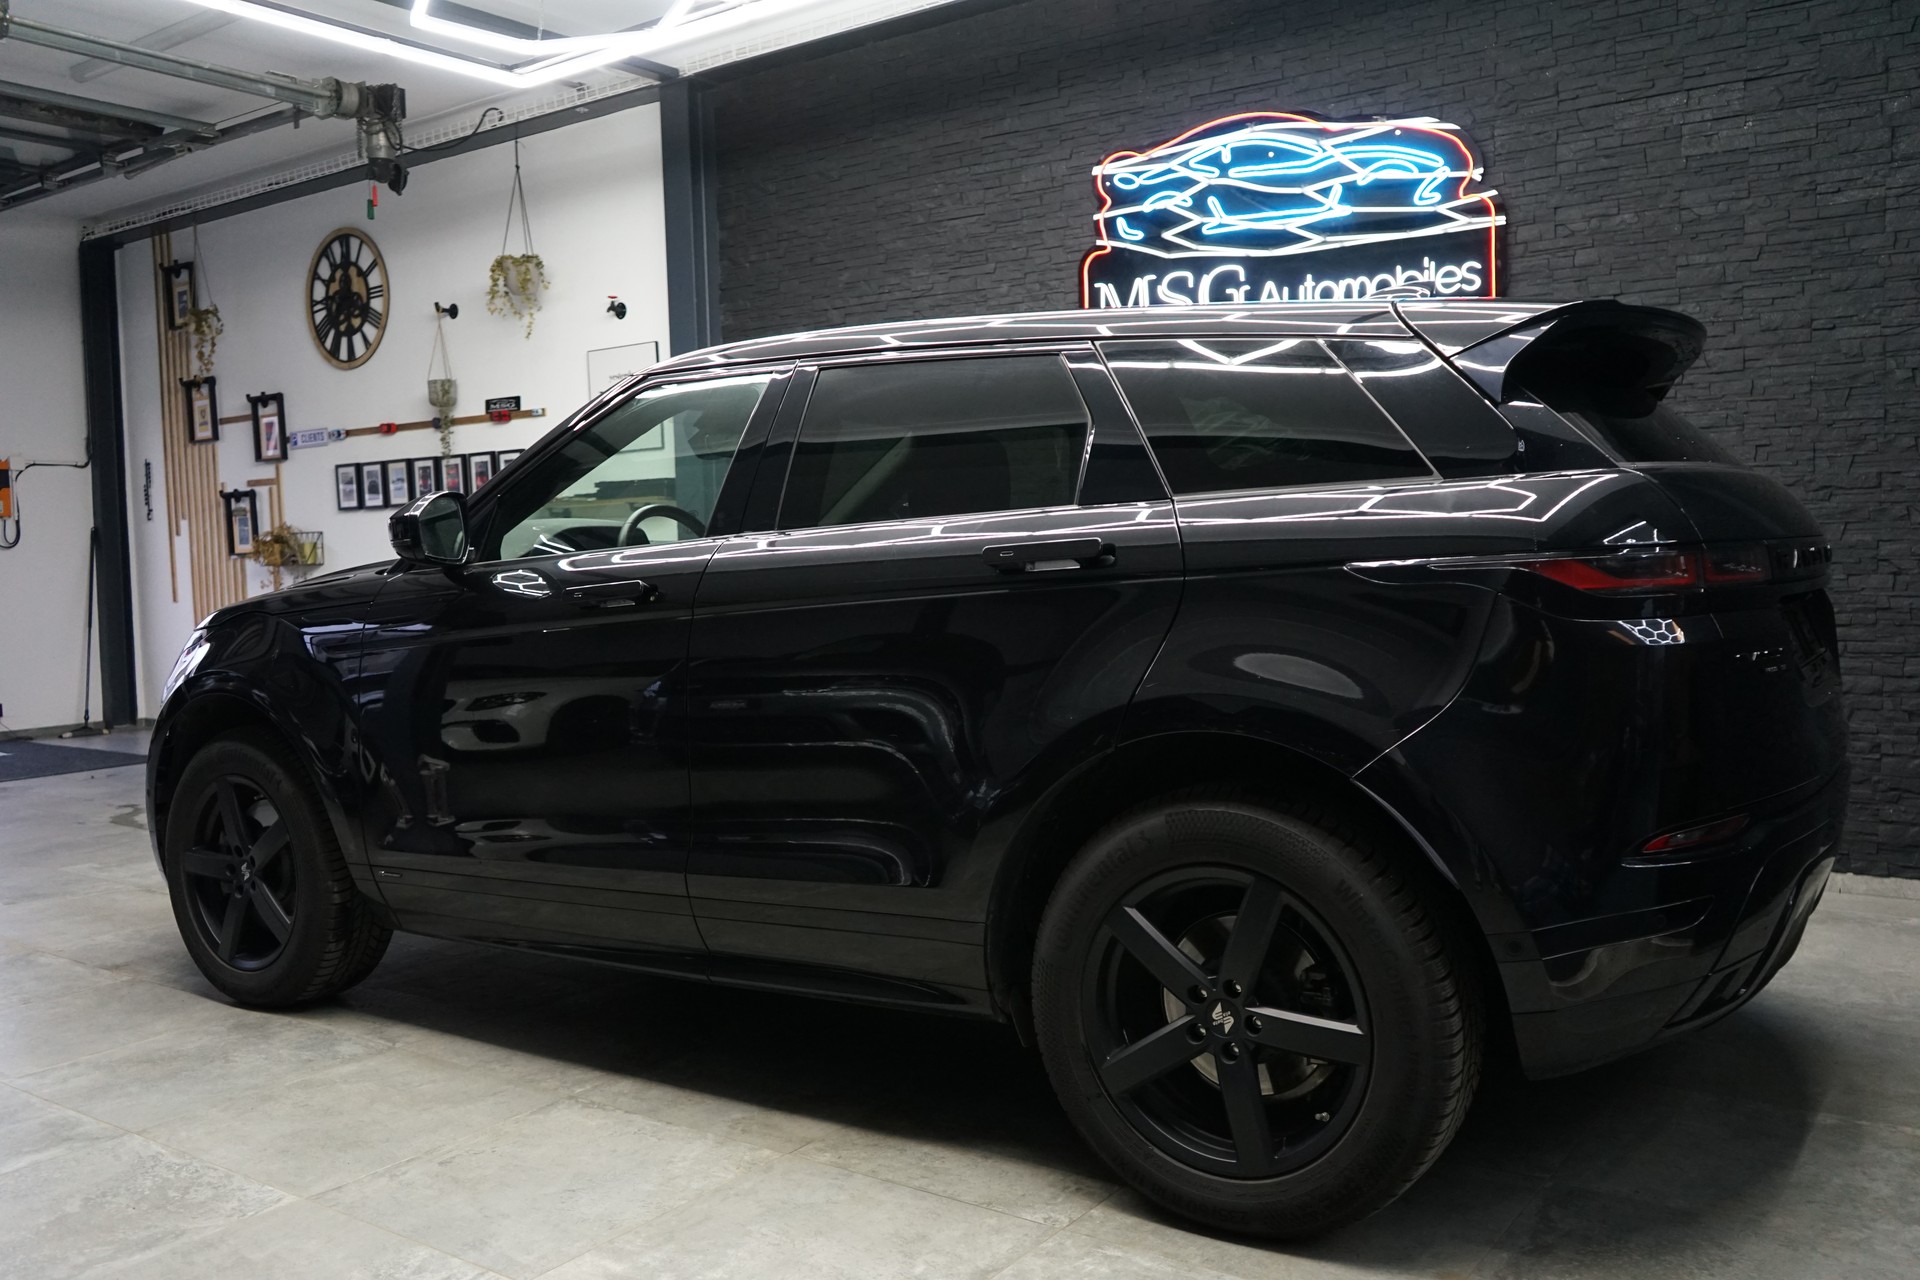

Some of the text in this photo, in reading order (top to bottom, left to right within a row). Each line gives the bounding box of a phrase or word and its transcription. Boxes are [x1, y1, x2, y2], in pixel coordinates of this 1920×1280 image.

[1094, 256, 1482, 309] MSG Automobiles
[301, 431, 324, 443] CLIENTS
